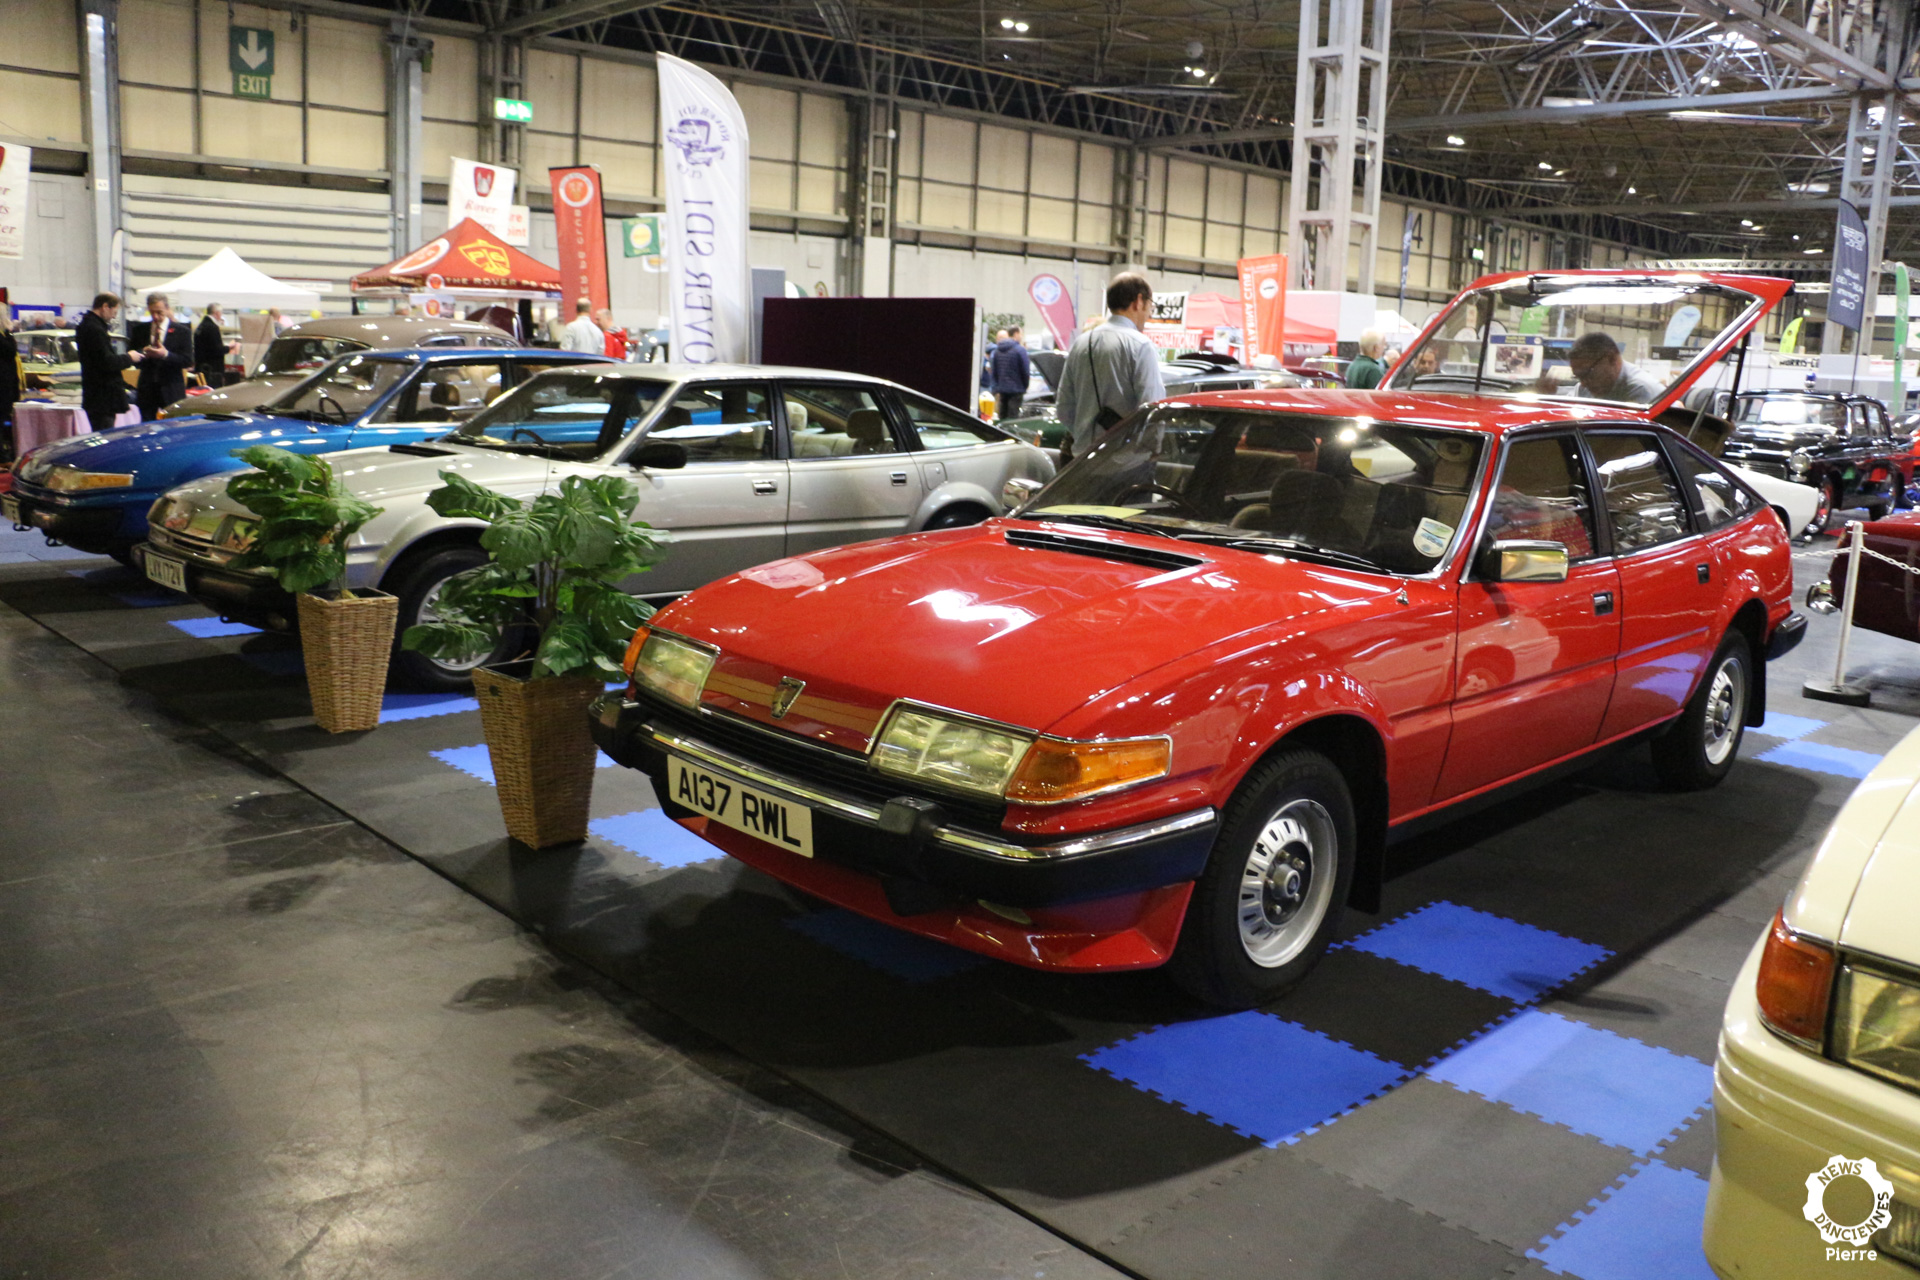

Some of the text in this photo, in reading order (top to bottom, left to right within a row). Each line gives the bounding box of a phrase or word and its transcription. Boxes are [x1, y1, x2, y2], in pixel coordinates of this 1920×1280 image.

[240, 74, 268, 95] EXIT
[465, 200, 497, 213] Rover
[446, 277, 468, 285] THE
[474, 278, 517, 286] ROVER
[679, 767, 802, 847] A137 RWL
